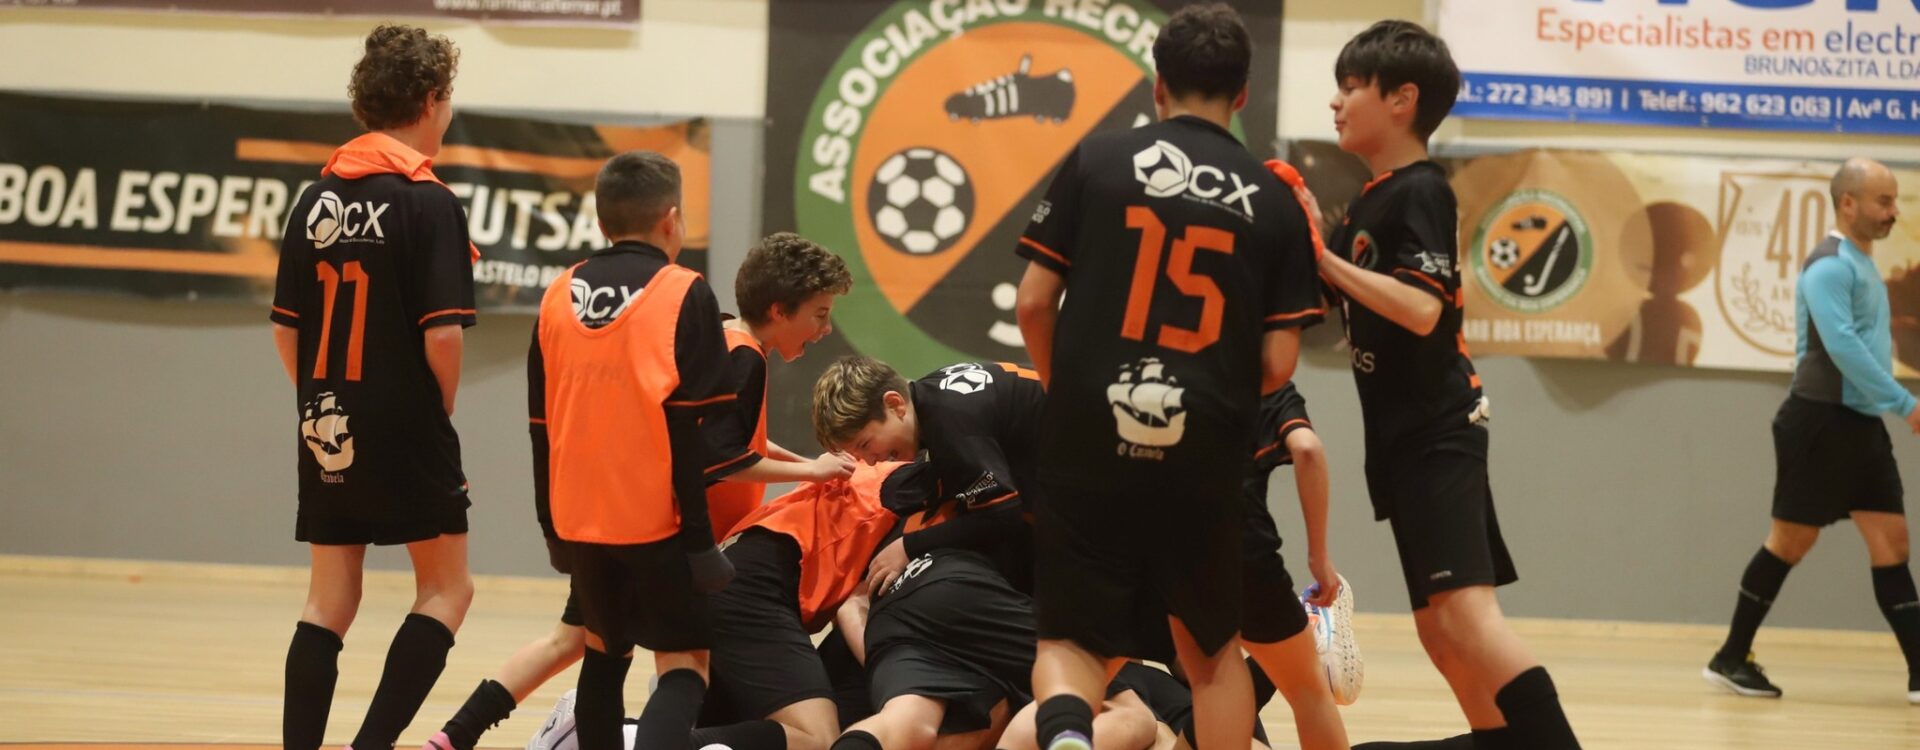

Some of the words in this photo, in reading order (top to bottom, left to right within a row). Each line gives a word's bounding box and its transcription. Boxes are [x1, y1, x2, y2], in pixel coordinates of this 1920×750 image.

[1536, 8, 1752, 50] Especialistas
[1762, 28, 1815, 51] em
[1744, 55, 1879, 78] BRUNO&ZITA
[1487, 82, 1526, 105] 272
[1530, 84, 1571, 108] 345
[1575, 87, 1612, 110] 891
[1701, 92, 1742, 114] 962
[1746, 94, 1785, 117] 623
[1790, 96, 1831, 119] 063
[0, 163, 99, 230] BOA
[109, 169, 311, 240] ESPER
[449, 182, 614, 251] UTSA
[1765, 188, 1826, 279] 40
[312, 261, 369, 381] 11
[1120, 205, 1235, 354] 15
